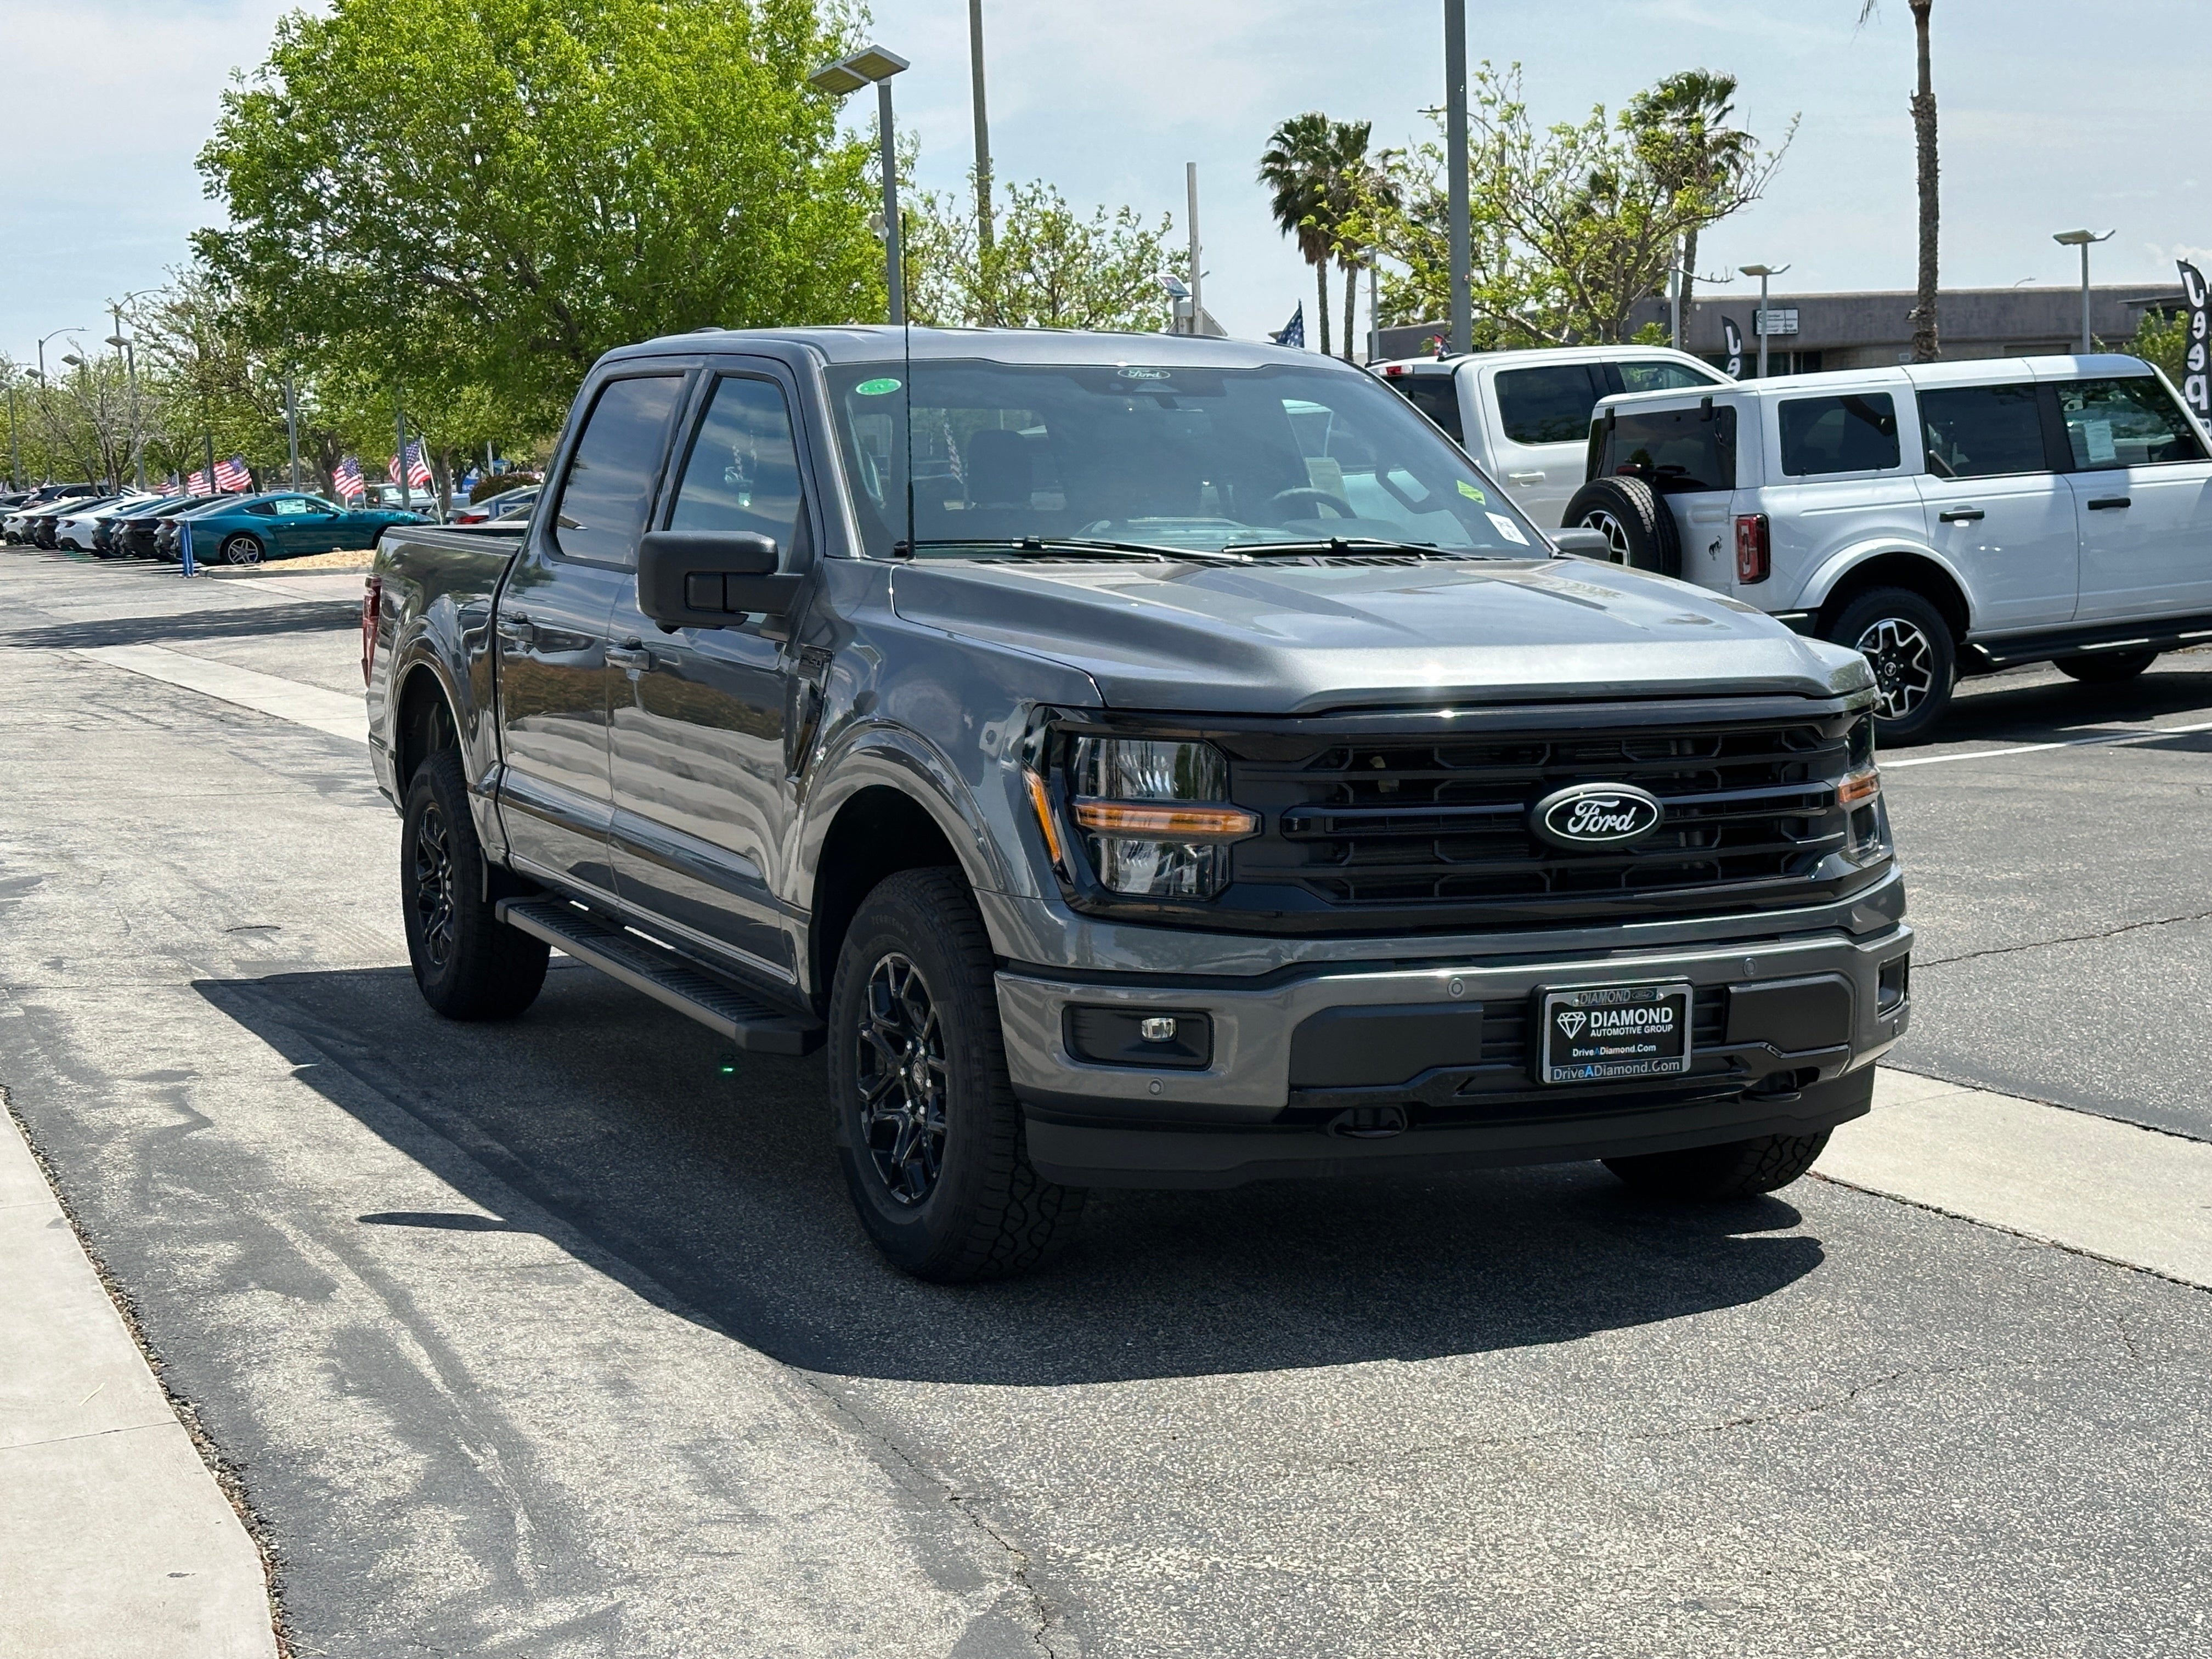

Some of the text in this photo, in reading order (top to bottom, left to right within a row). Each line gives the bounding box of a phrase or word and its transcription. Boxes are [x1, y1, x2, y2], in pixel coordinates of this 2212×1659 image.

[1128, 368, 1160, 378] Ford
[1567, 800, 1637, 833] Ford
[1581, 989, 1630, 1005] DIAMOND
[1591, 1007, 1673, 1028] DIAMOND
[1590, 1024, 1673, 1037] AUTOMOTIVE GROUP
[1554, 1060, 1679, 1080] DriveADiamond.Com
